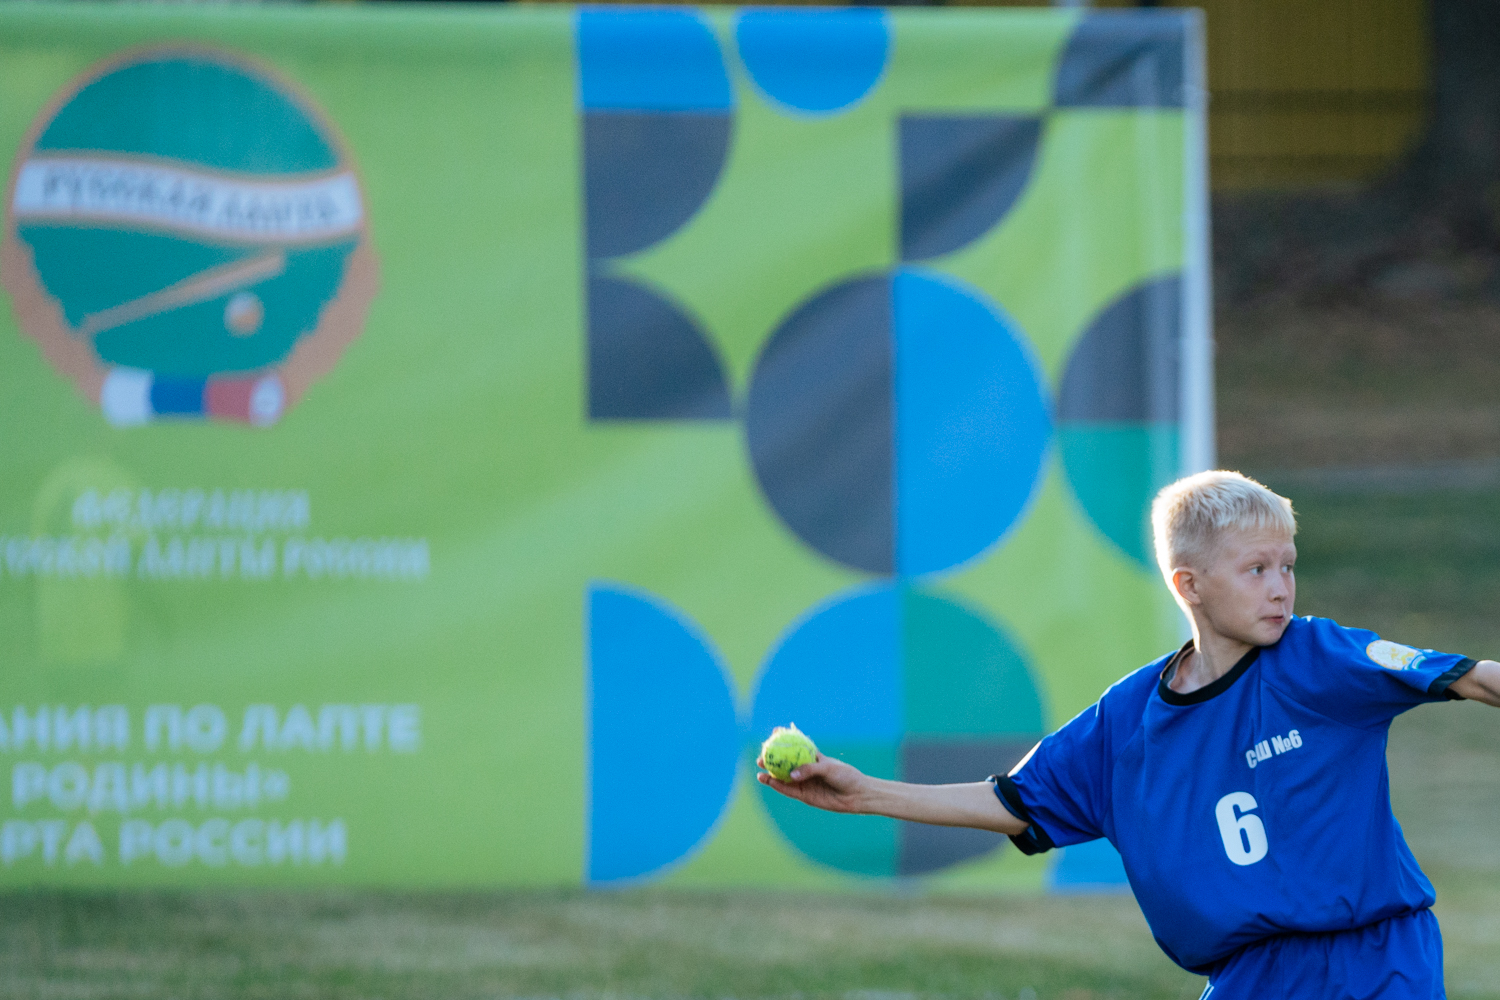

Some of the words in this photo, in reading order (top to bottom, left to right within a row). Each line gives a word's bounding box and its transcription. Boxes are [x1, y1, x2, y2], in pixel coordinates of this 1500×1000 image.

[143, 703, 229, 752] ПО
[238, 703, 421, 753] ЛАПТЕ
[1271, 729, 1303, 756] №6
[118, 818, 348, 865] РОССИИ
[1215, 791, 1268, 866] 6
